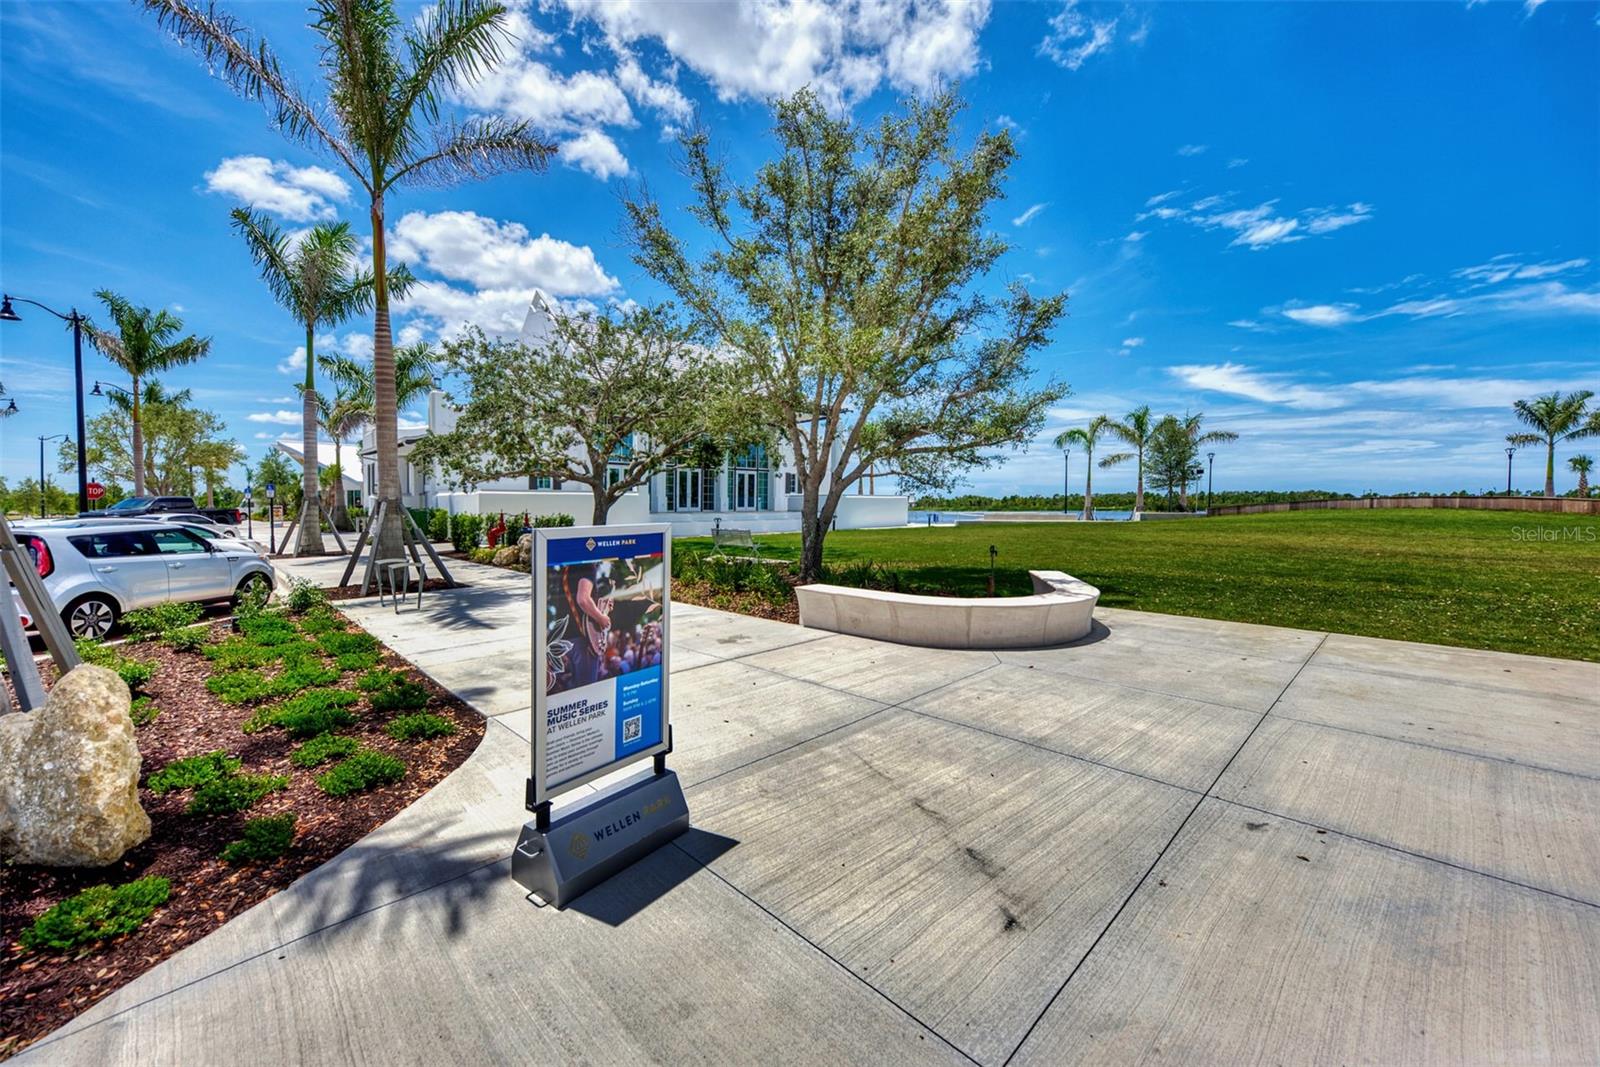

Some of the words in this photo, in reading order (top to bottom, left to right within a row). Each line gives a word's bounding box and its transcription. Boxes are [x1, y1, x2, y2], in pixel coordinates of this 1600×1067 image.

[88, 487, 104, 495] TOP
[547, 699, 588, 718] SUMMER
[547, 711, 577, 727] MUSIC
[579, 700, 609, 716] SERIES
[546, 726, 556, 735] AT
[558, 716, 587, 732] WELLEN
[588, 710, 606, 721] PARK
[593, 811, 641, 842] WELLEN
